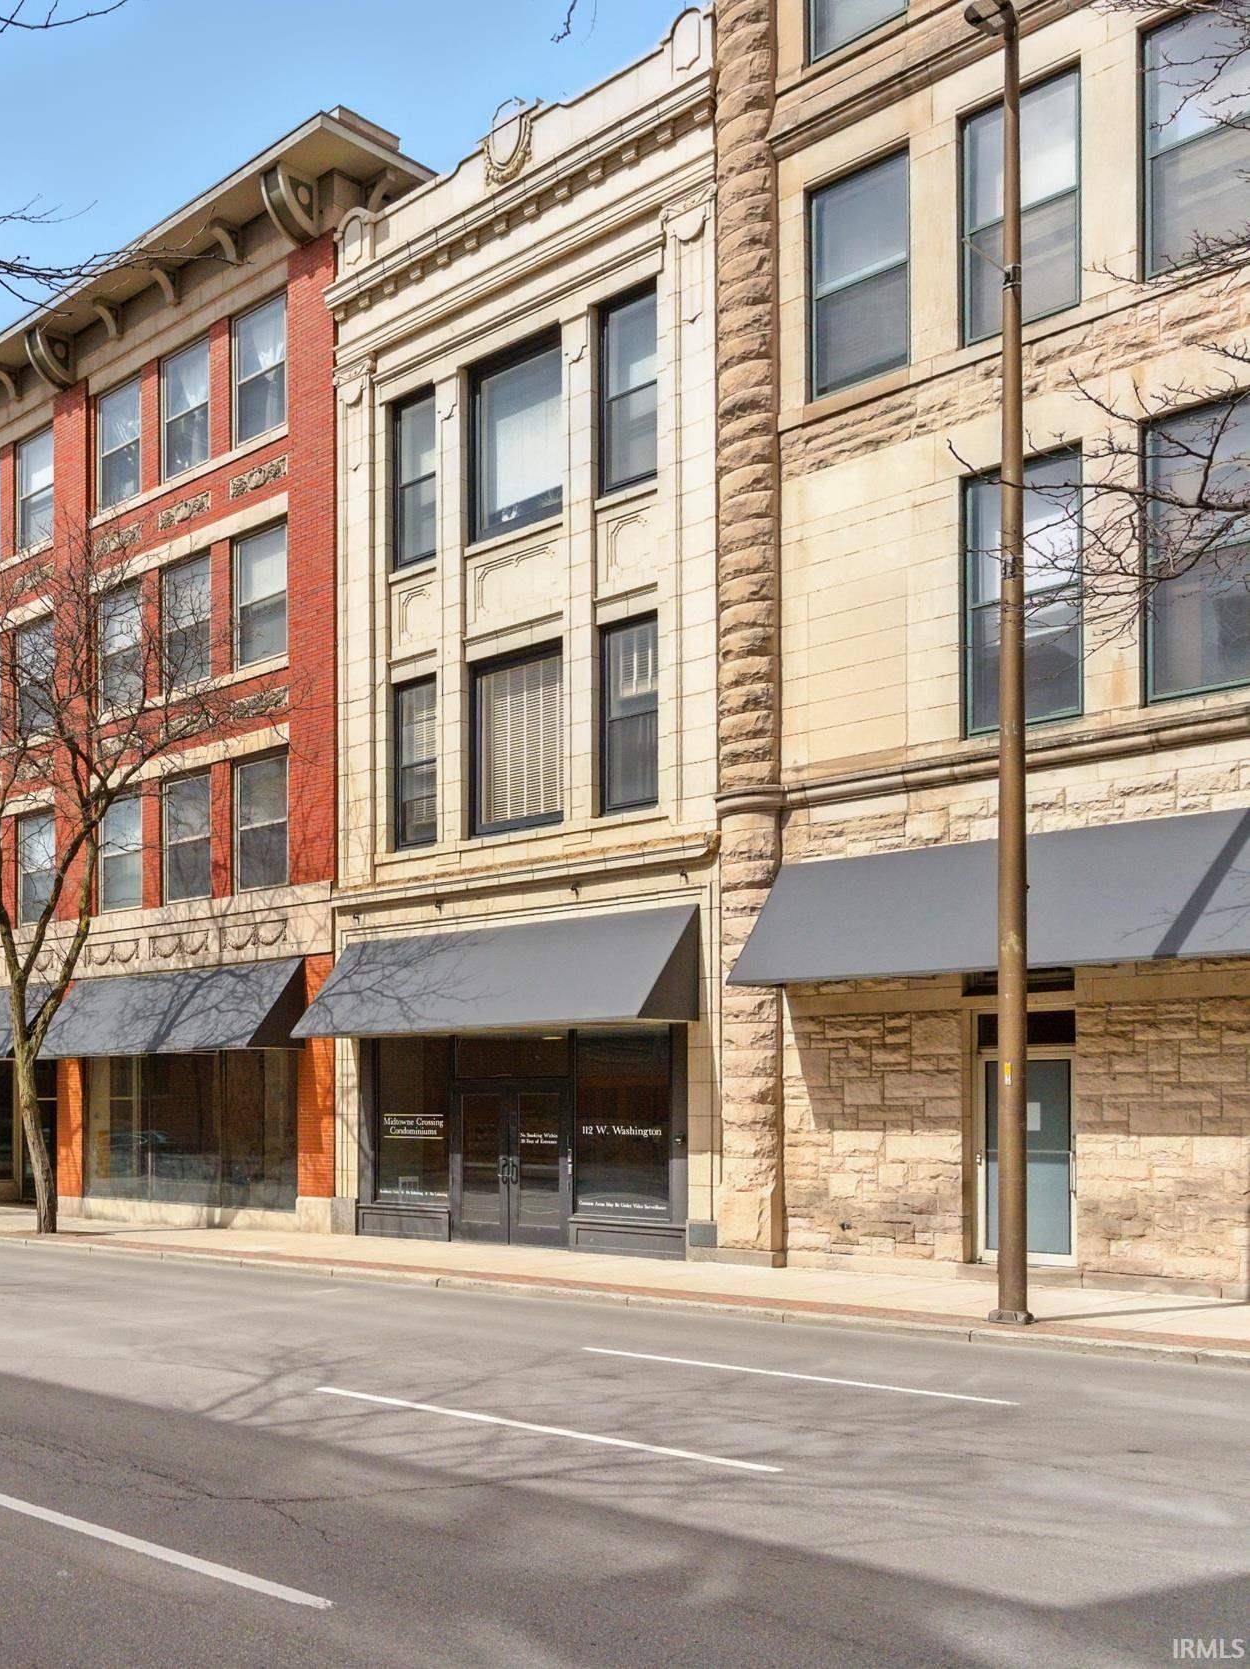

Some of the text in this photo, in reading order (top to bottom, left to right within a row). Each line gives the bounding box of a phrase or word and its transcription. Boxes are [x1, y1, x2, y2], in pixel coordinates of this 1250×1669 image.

[383, 1117, 444, 1128] Midtowne Crossing
[389, 1126, 438, 1135] Condominiums
[582, 1125, 662, 1138] 112 W. Washington
